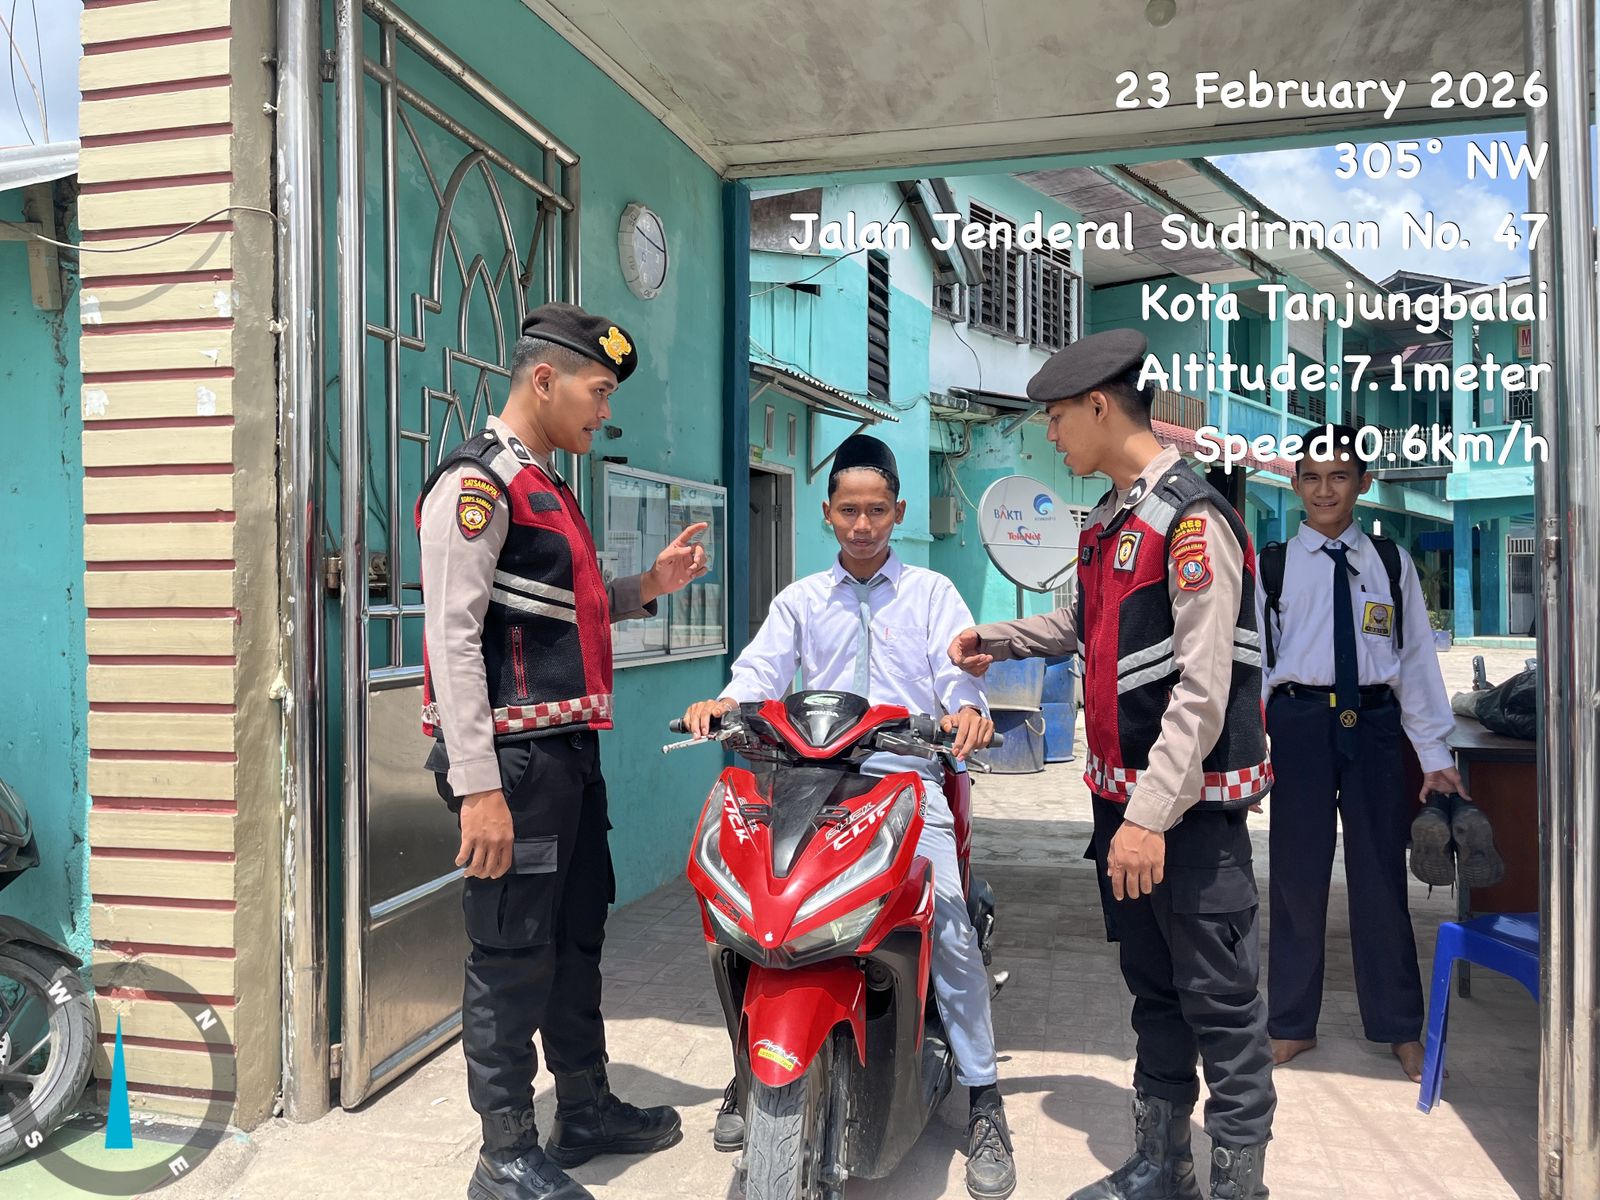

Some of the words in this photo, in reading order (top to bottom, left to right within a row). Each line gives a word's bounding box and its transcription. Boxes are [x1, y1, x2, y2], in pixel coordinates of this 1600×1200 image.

[994, 505, 1023, 521] BAKTI
[1172, 519, 1202, 537] LRES
[806, 710, 840, 718] HONDA
